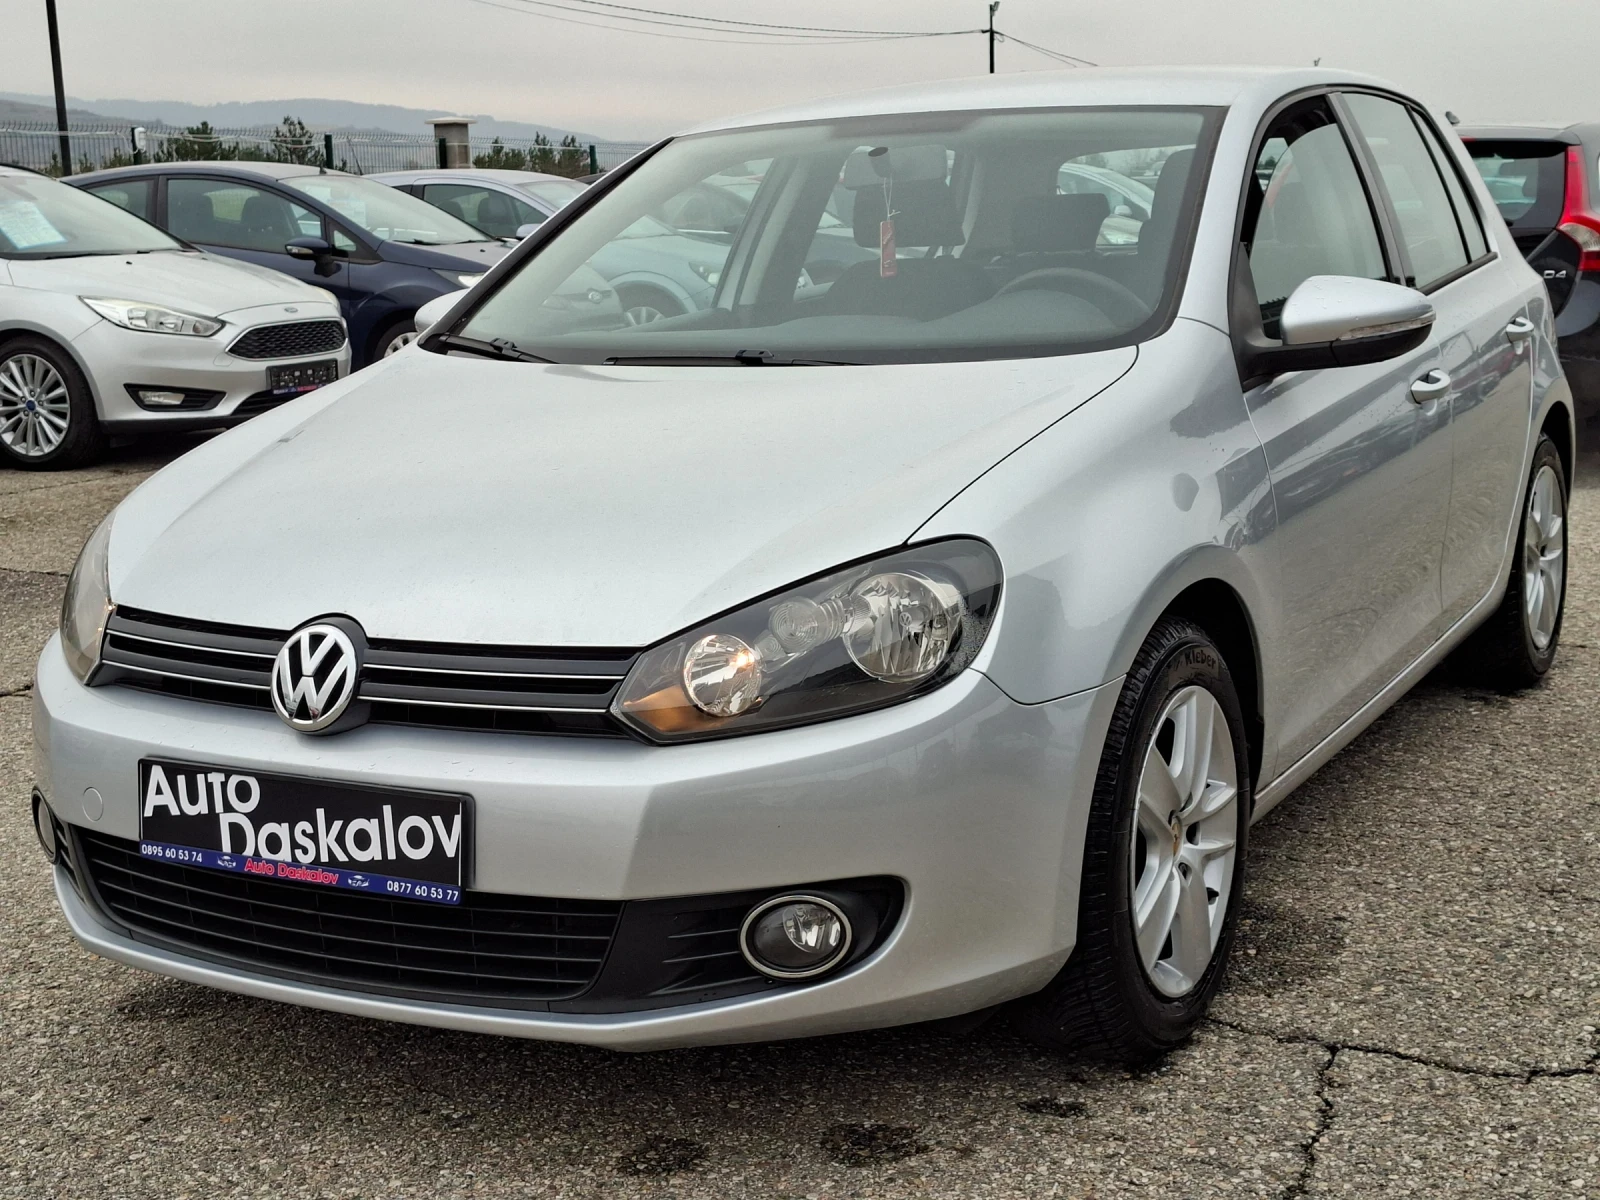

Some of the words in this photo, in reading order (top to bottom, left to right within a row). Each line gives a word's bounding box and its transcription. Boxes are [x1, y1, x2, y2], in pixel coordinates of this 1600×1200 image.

[1544, 270, 1566, 278] D4
[1184, 649, 1217, 669] Kleber
[219, 804, 461, 864] Daskalov
[141, 844, 163, 856] 0895
[165, 848, 177, 859] 60
[178, 849, 189, 861] 53
[191, 851, 203, 863] 74
[244, 858, 275, 875] Auto
[278, 863, 339, 884] Daskalov
[386, 880, 412, 894] 0877
[414, 885, 428, 897] 60
[430, 887, 443, 899] 53
[446, 889, 459, 901] 77
